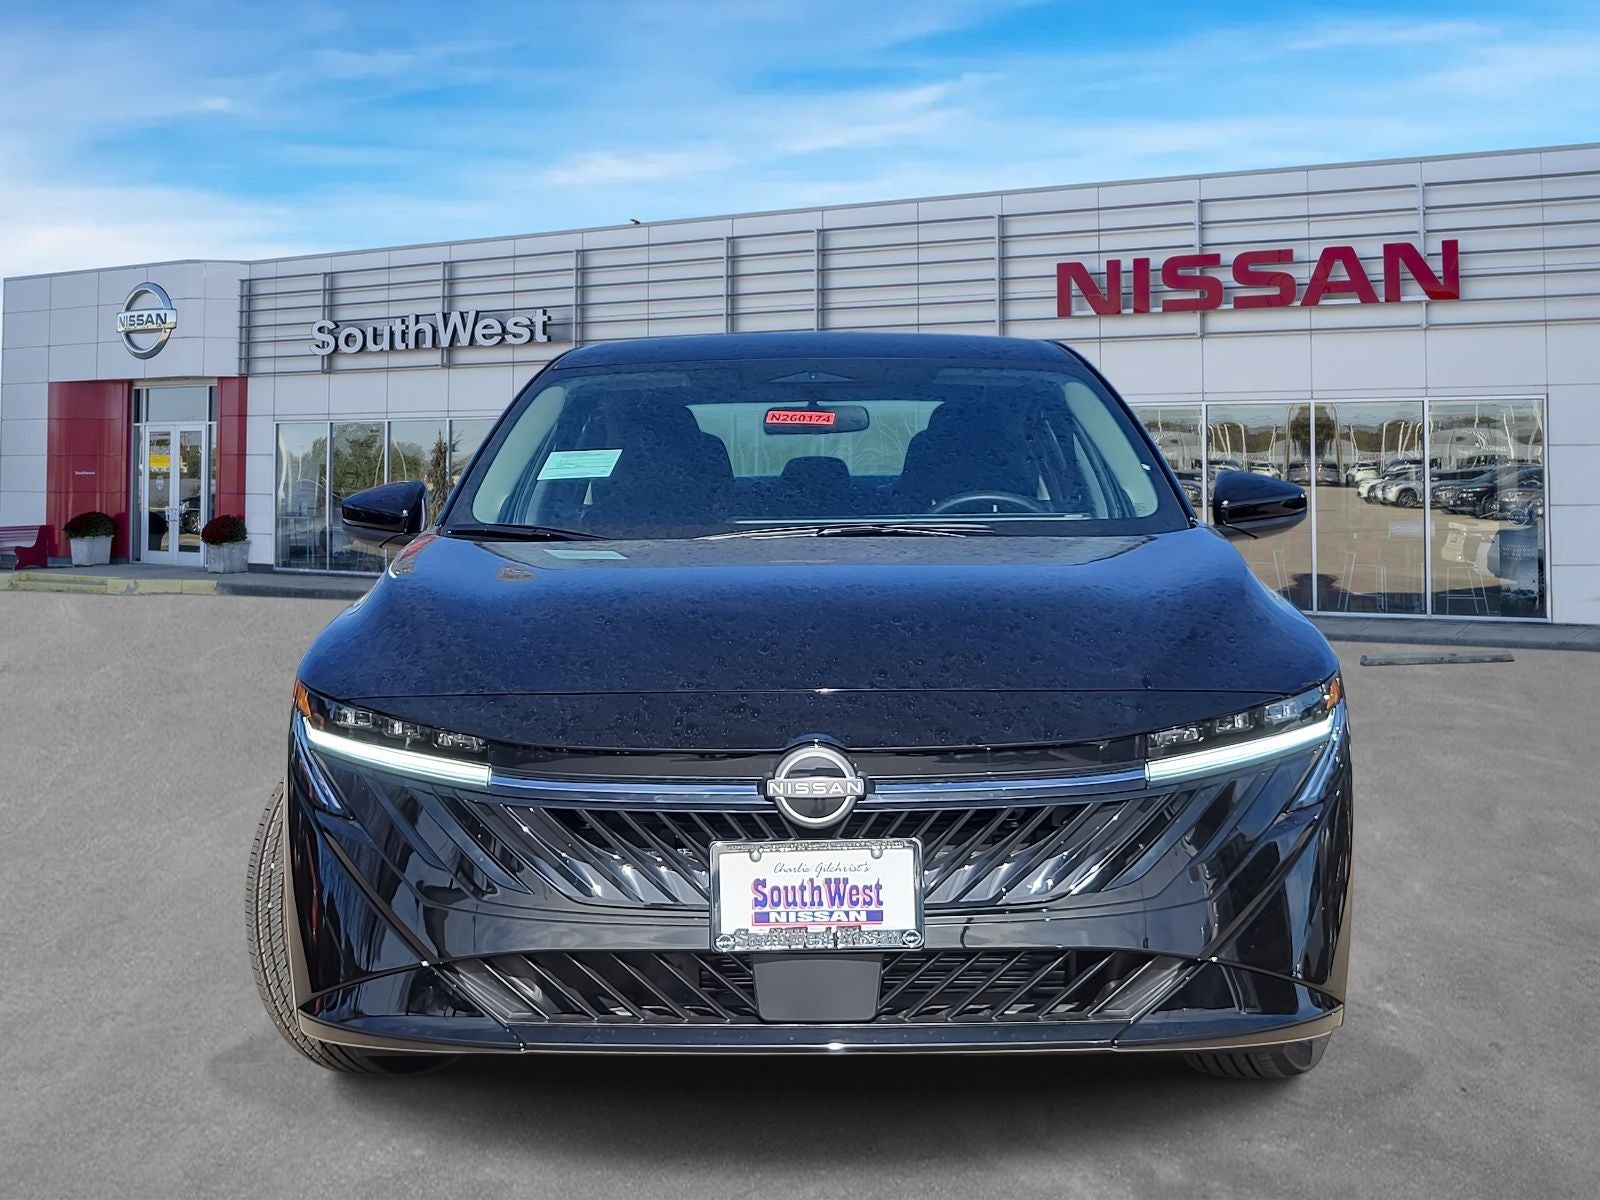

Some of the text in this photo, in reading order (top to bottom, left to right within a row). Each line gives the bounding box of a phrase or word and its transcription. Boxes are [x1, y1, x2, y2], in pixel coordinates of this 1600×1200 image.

[1056, 239, 1461, 318] NISSAN
[119, 312, 168, 329] NISSAN
[308, 308, 551, 356] SouthWest
[770, 412, 831, 422] N260174
[768, 781, 864, 796] NISSAN
[773, 861, 812, 873] Charlie
[751, 876, 885, 909] SouthWest
[769, 910, 868, 922] NISSAN
